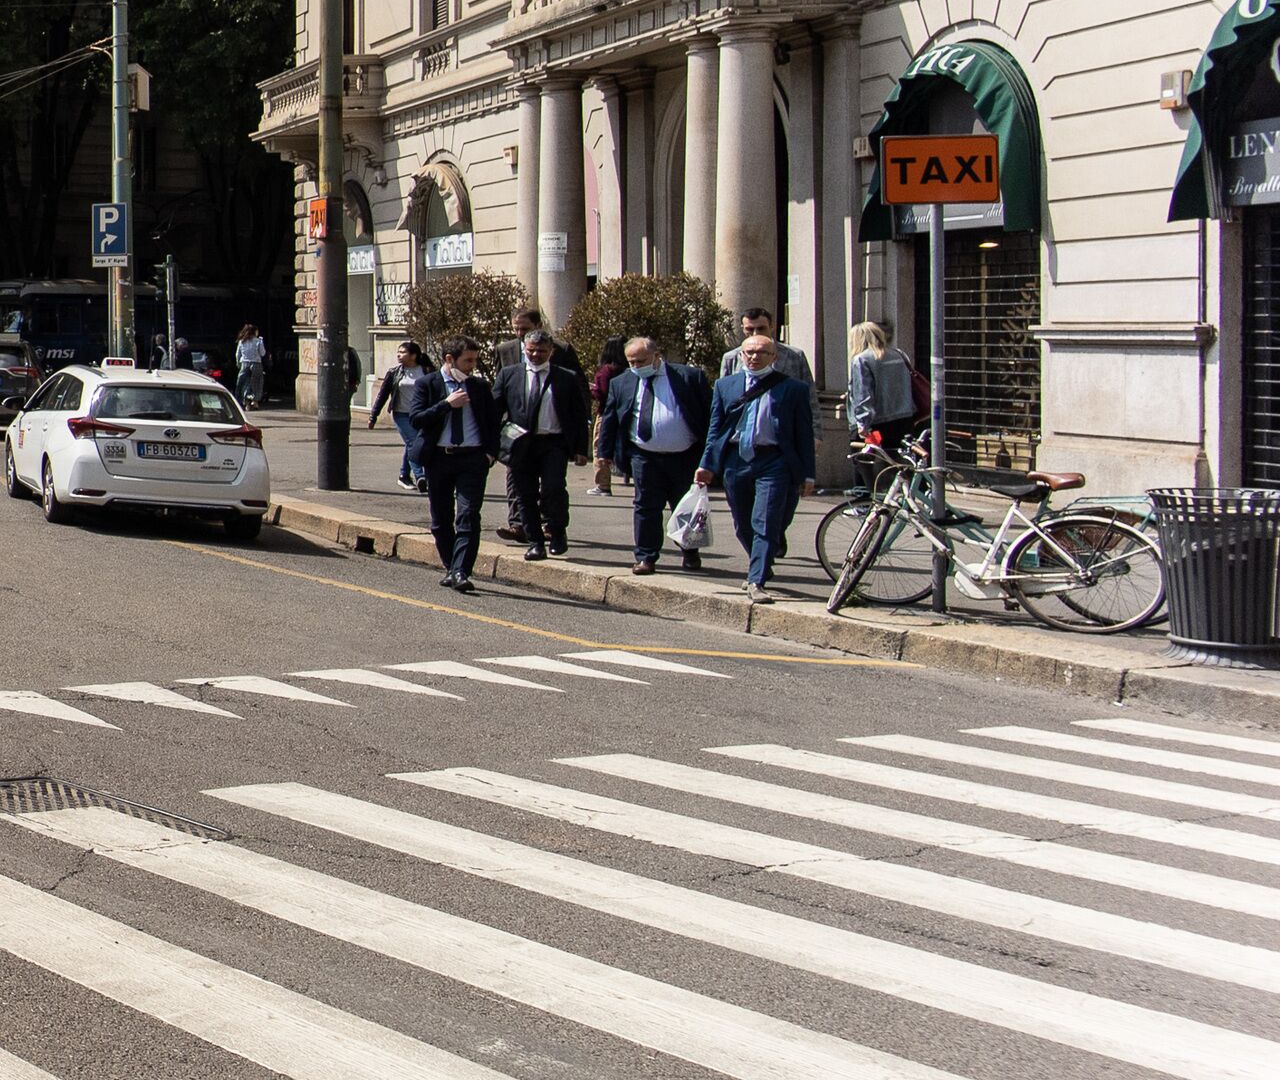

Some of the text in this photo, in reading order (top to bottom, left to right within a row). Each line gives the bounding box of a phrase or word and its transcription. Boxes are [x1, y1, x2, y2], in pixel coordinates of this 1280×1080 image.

[1230, 130, 1280, 159] LEN
[890, 155, 993, 185] TAXI
[99, 207, 119, 232] P
[46, 348, 75, 359] msi
[105, 445, 125, 454] 3334
[145, 444, 198, 457] FB 603ZC
